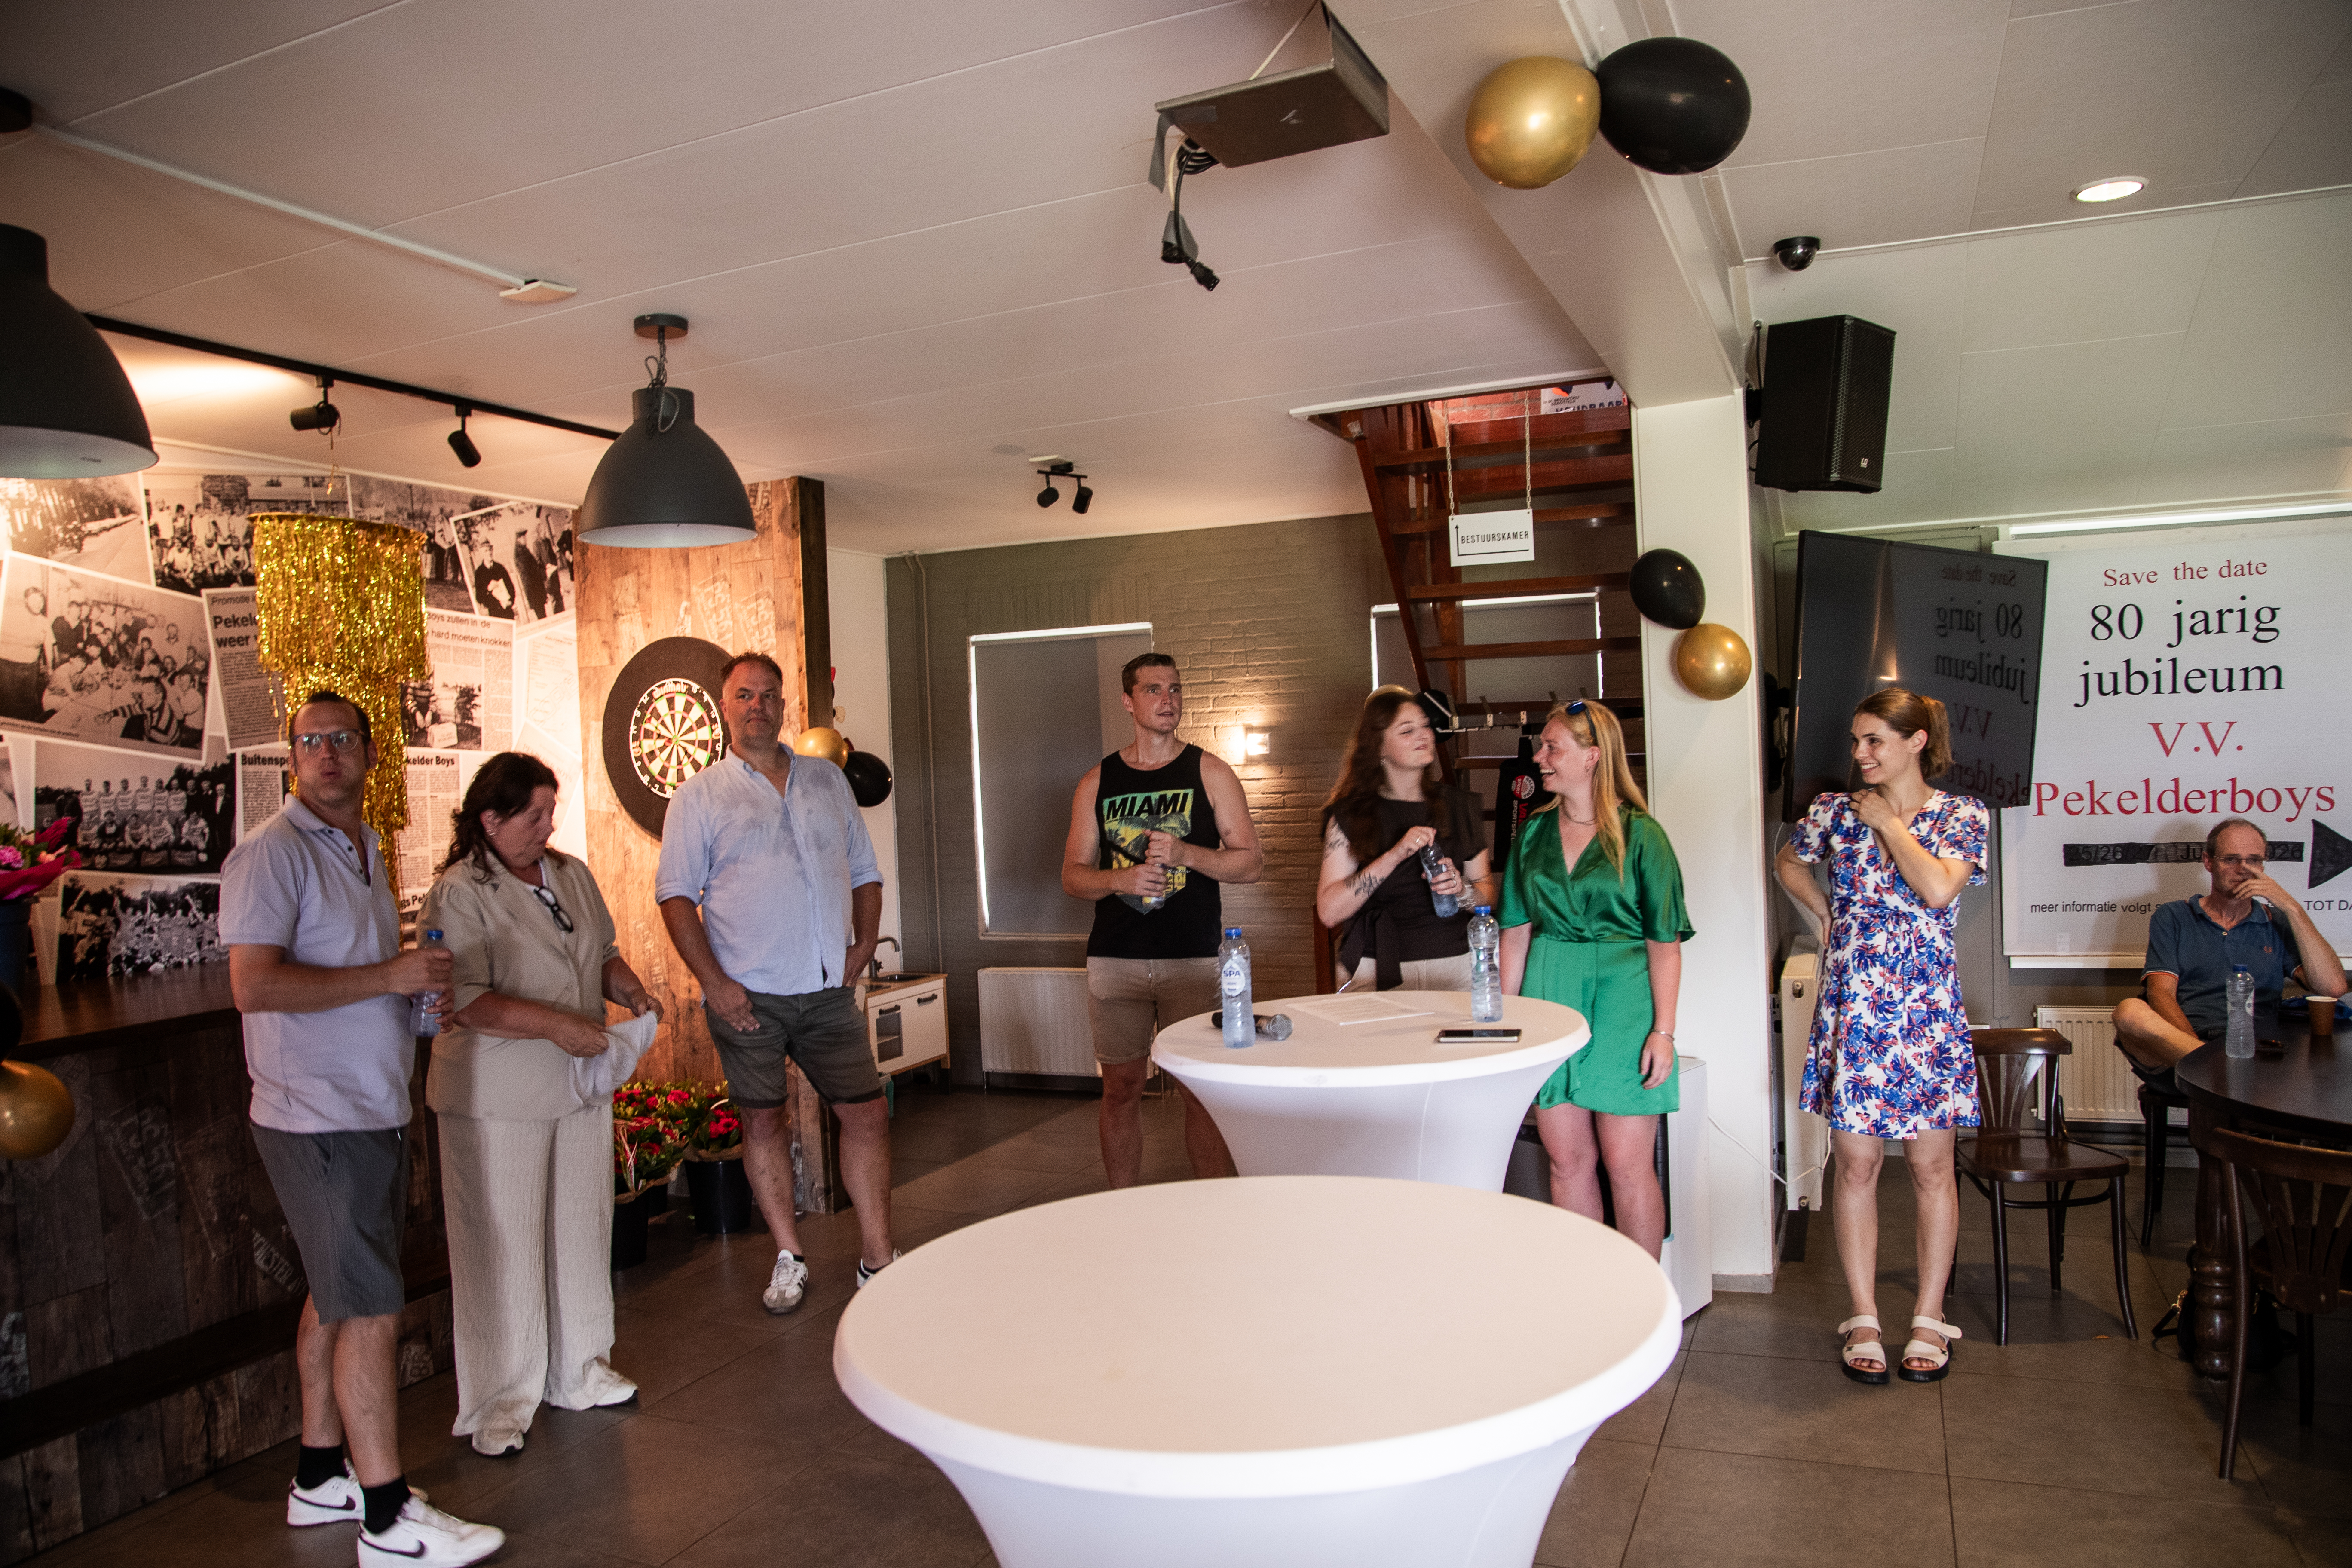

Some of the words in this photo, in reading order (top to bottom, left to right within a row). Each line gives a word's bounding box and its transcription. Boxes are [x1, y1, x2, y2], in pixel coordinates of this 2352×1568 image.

[1461, 531, 1529, 544] BESTUURSKAMER
[2104, 569, 2158, 587] Save
[2173, 562, 2208, 581] the
[2218, 559, 2268, 579] date
[431, 629, 450, 639] hard
[2090, 603, 2144, 641] 80
[2167, 595, 2281, 648] jarig
[216, 635, 251, 648] weer
[2074, 657, 2285, 708] jubileum
[2147, 721, 2244, 758] V.V.
[435, 756, 455, 768] Boys
[1106, 792, 1190, 821] MIAMI
[2032, 777, 2335, 823] Pekelderboys
[2031, 903, 2059, 913] meer
[2062, 901, 2117, 912] informatie
[2121, 903, 2152, 915] volgt
[2304, 900, 2334, 911] TOT
